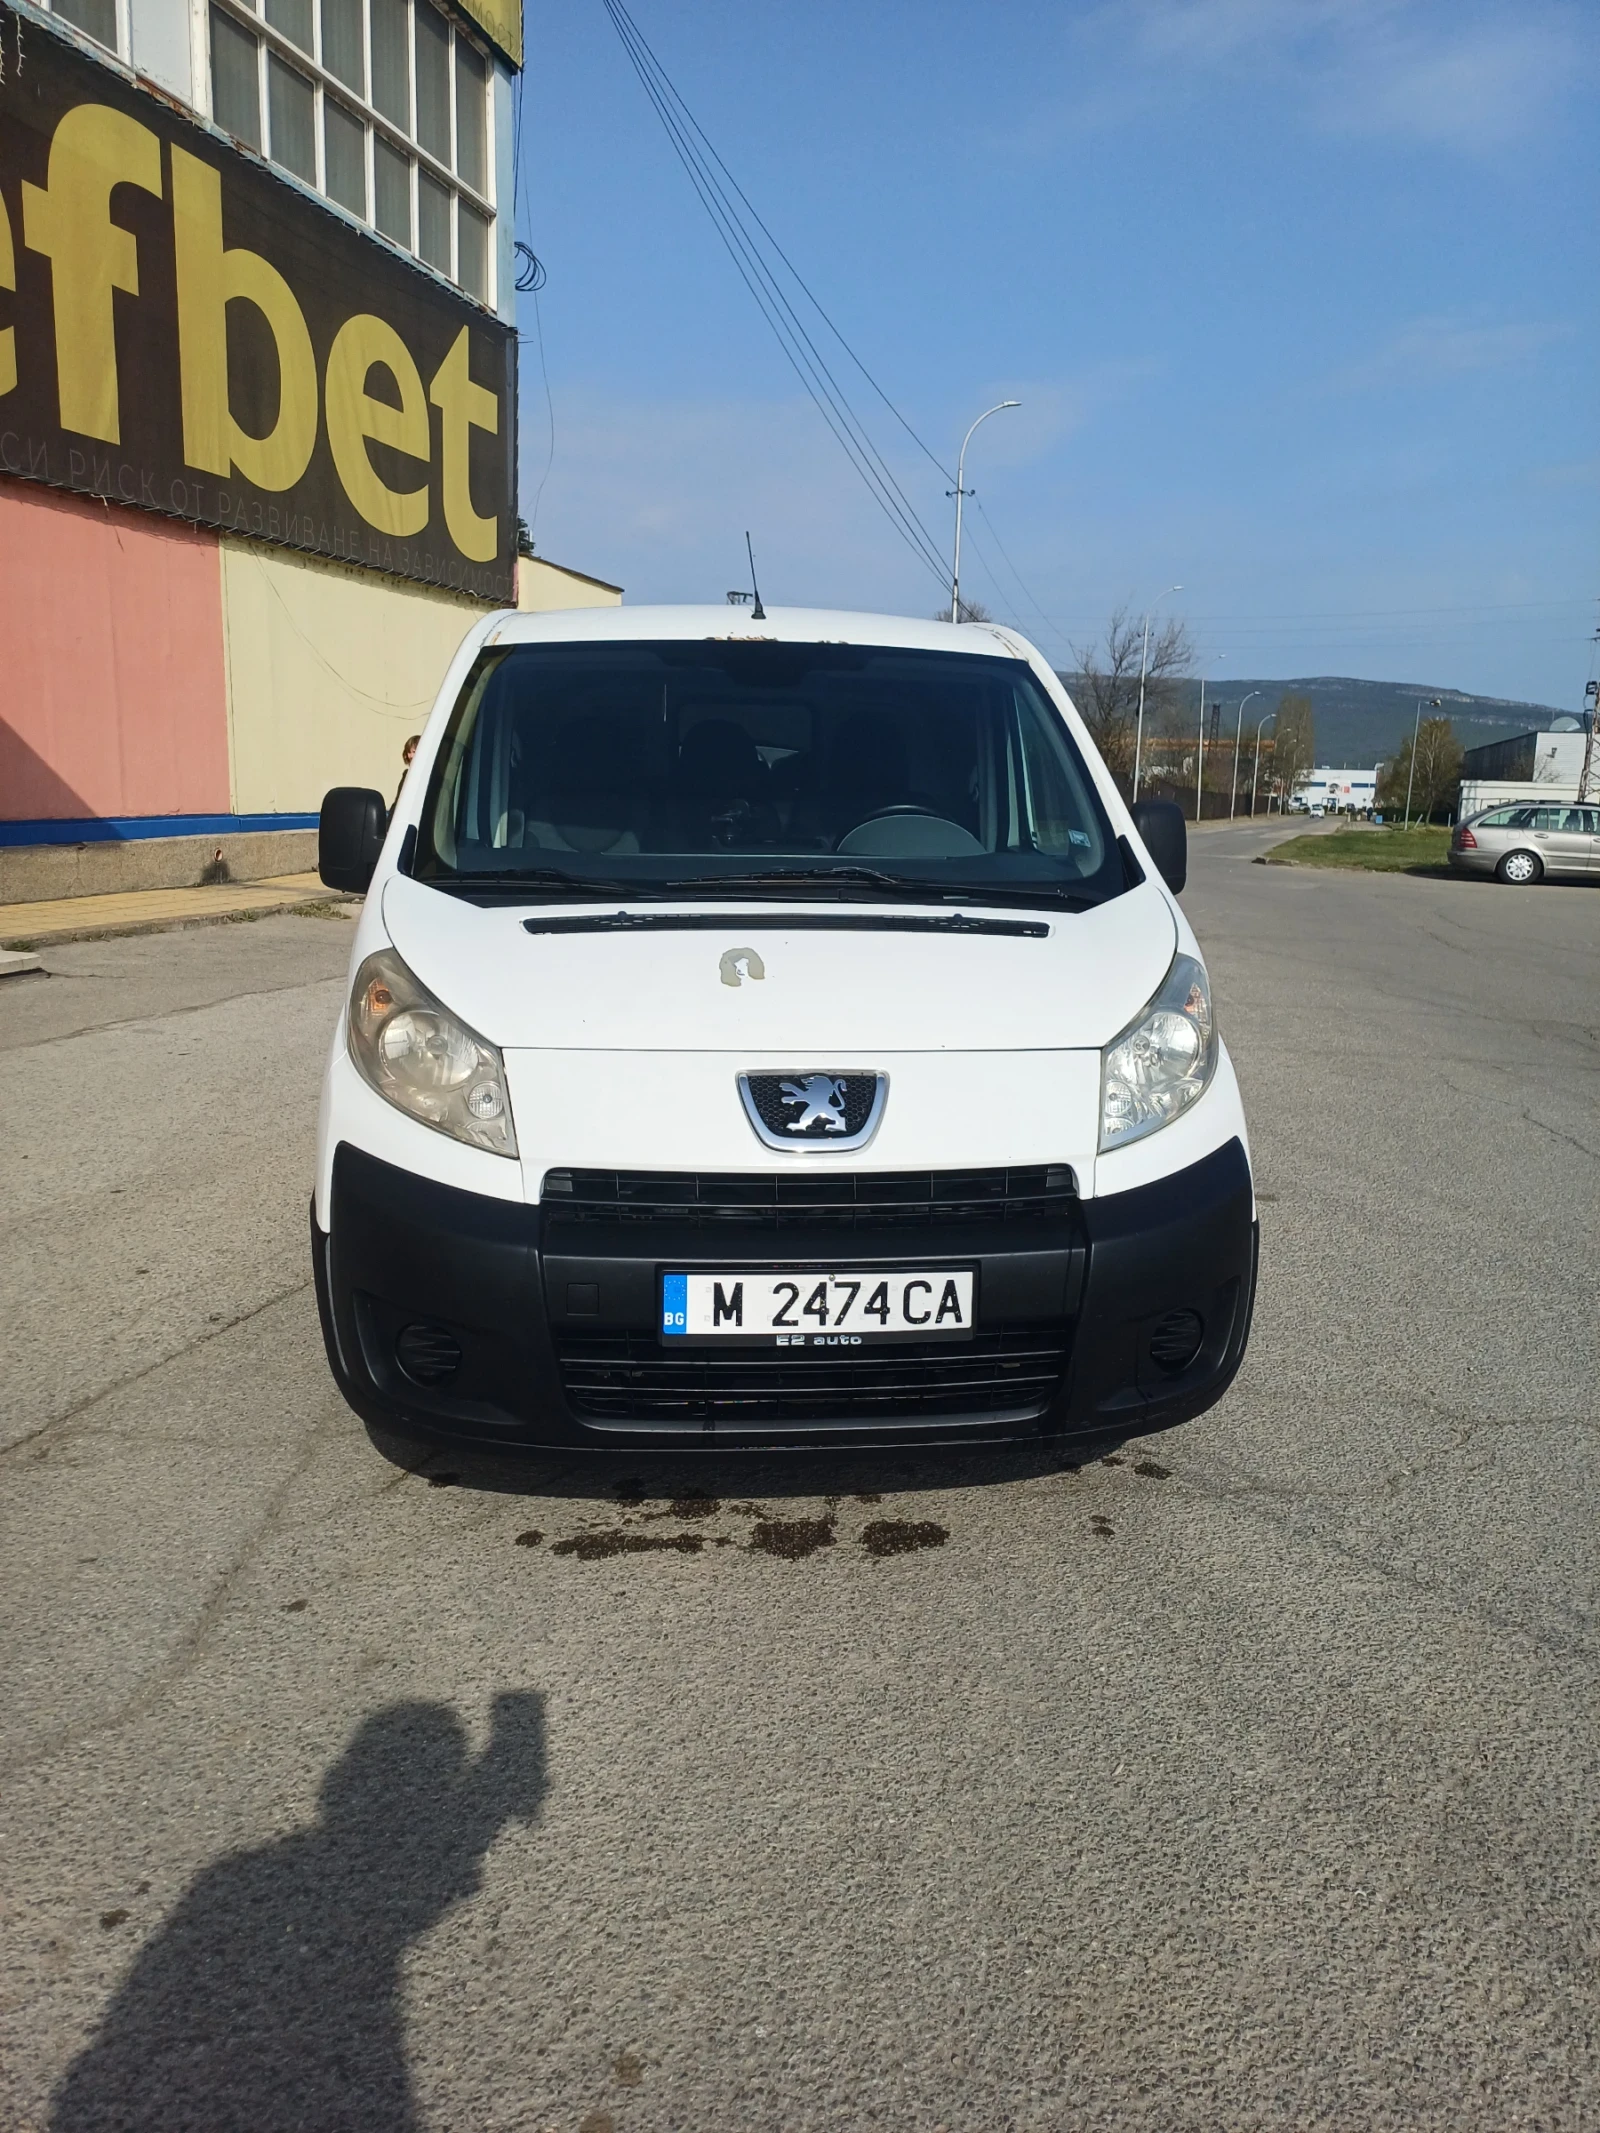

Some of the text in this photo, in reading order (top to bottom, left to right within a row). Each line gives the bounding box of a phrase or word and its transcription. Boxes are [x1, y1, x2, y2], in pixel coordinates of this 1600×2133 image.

[70, 447, 157, 505] РИСК
[170, 478, 205, 518] ОТ
[218, 491, 360, 560] РАЗВИВАНЕ
[368, 540, 394, 566] НА
[402, 546, 512, 597] ЗАВИСИМОСТ
[712, 1281, 744, 1327] M
[663, 1312, 685, 1327] BG
[812, 1334, 863, 1346] auto
